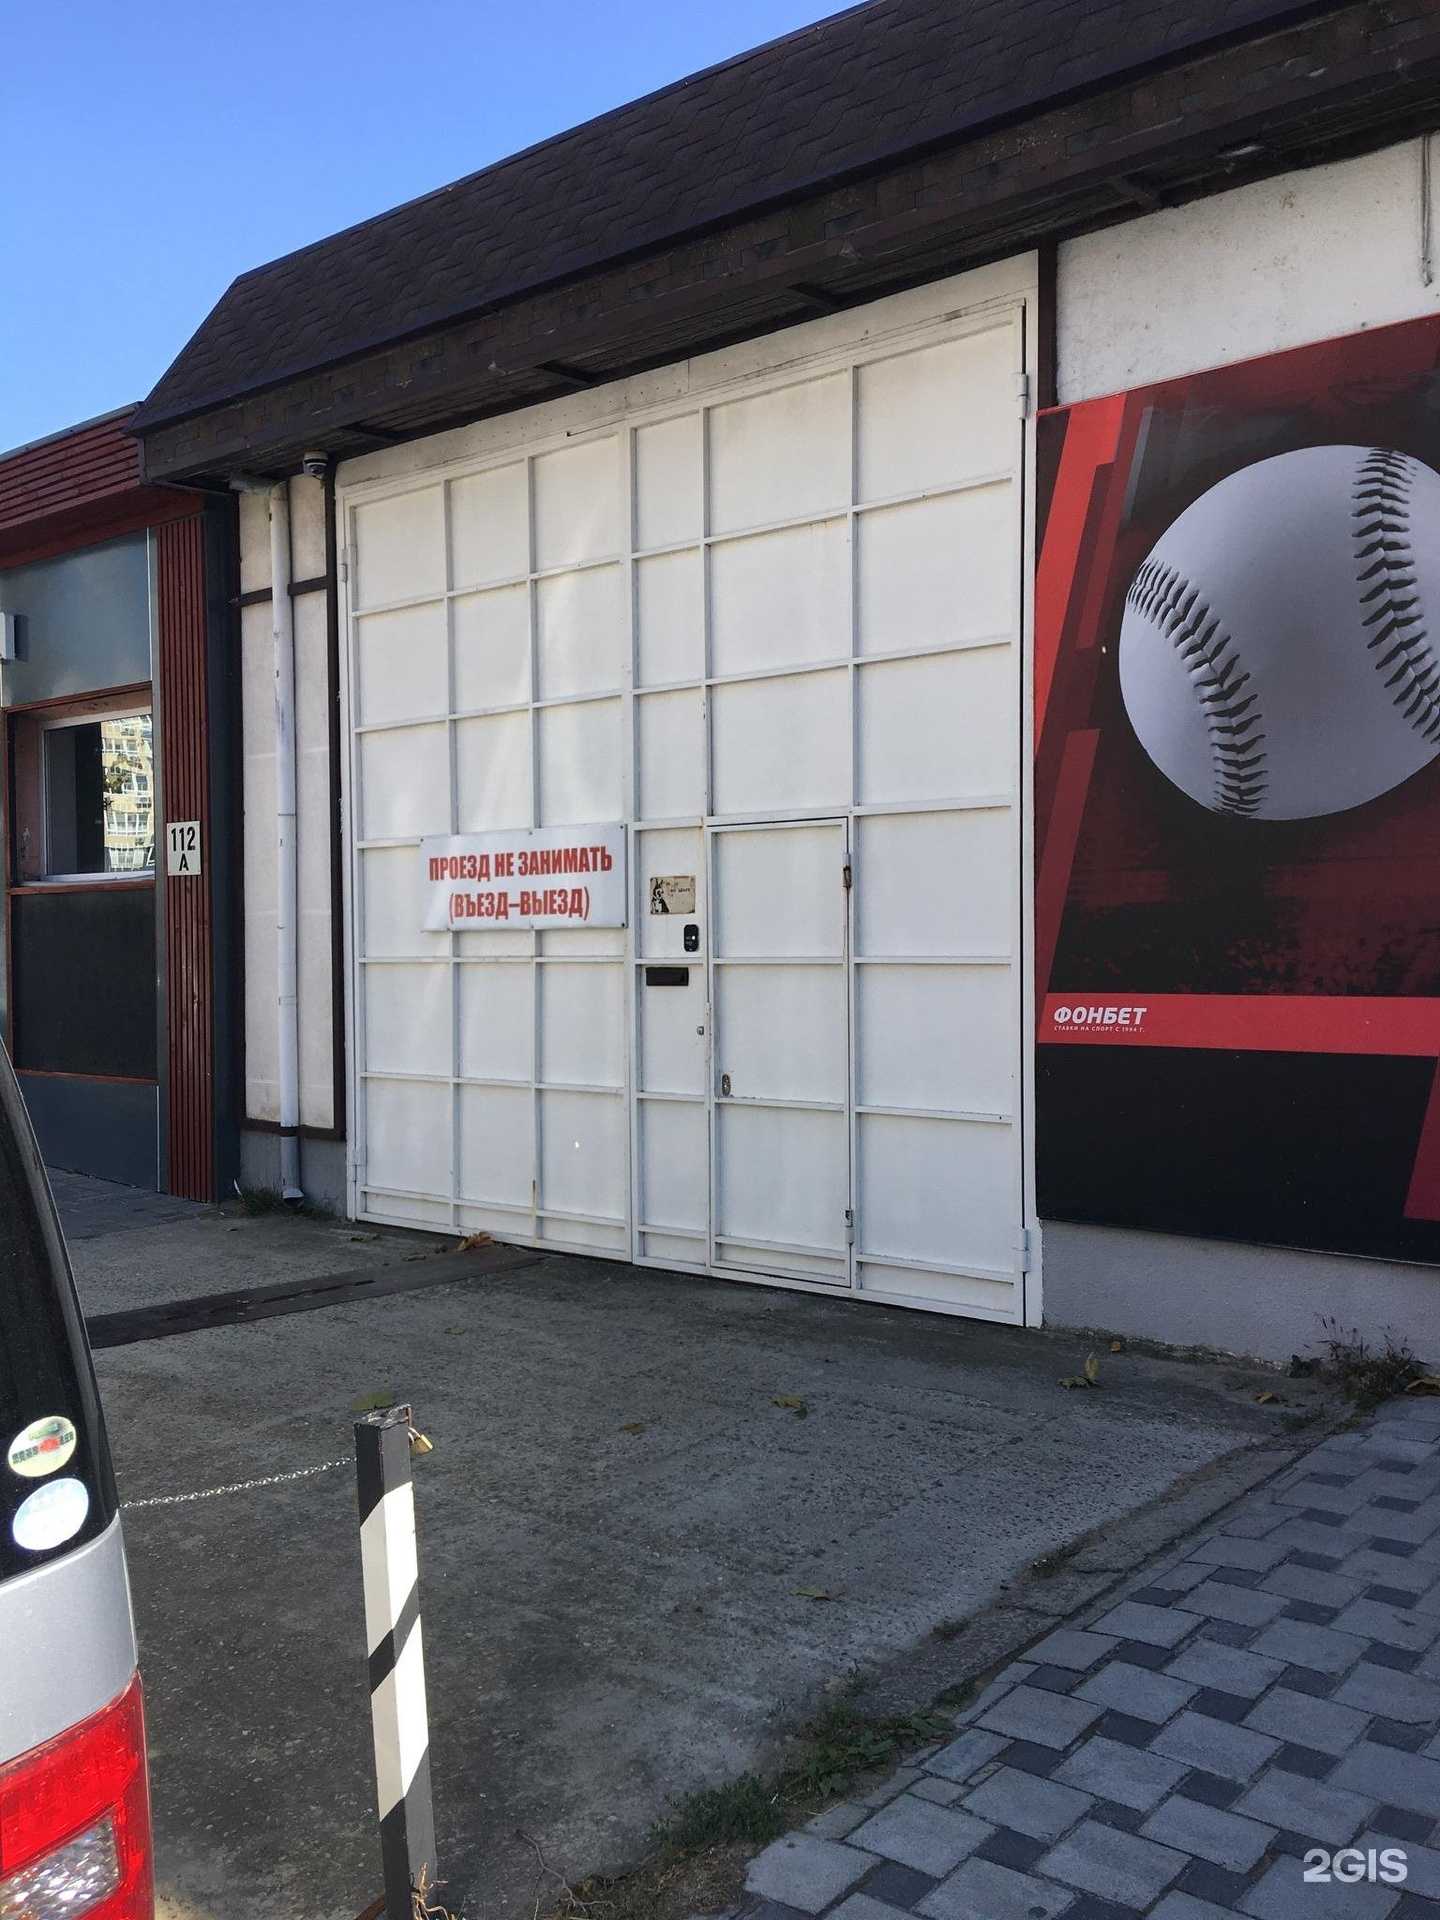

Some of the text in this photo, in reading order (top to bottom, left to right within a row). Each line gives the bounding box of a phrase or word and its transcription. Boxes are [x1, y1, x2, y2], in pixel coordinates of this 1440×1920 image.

[171, 827, 196, 852] 112
[179, 853, 189, 872] А
[429, 846, 613, 882] ПРОЕЗД НЕ ЗАНИМАТЬ
[1054, 1006, 1147, 1025] ФОНБЕТ
